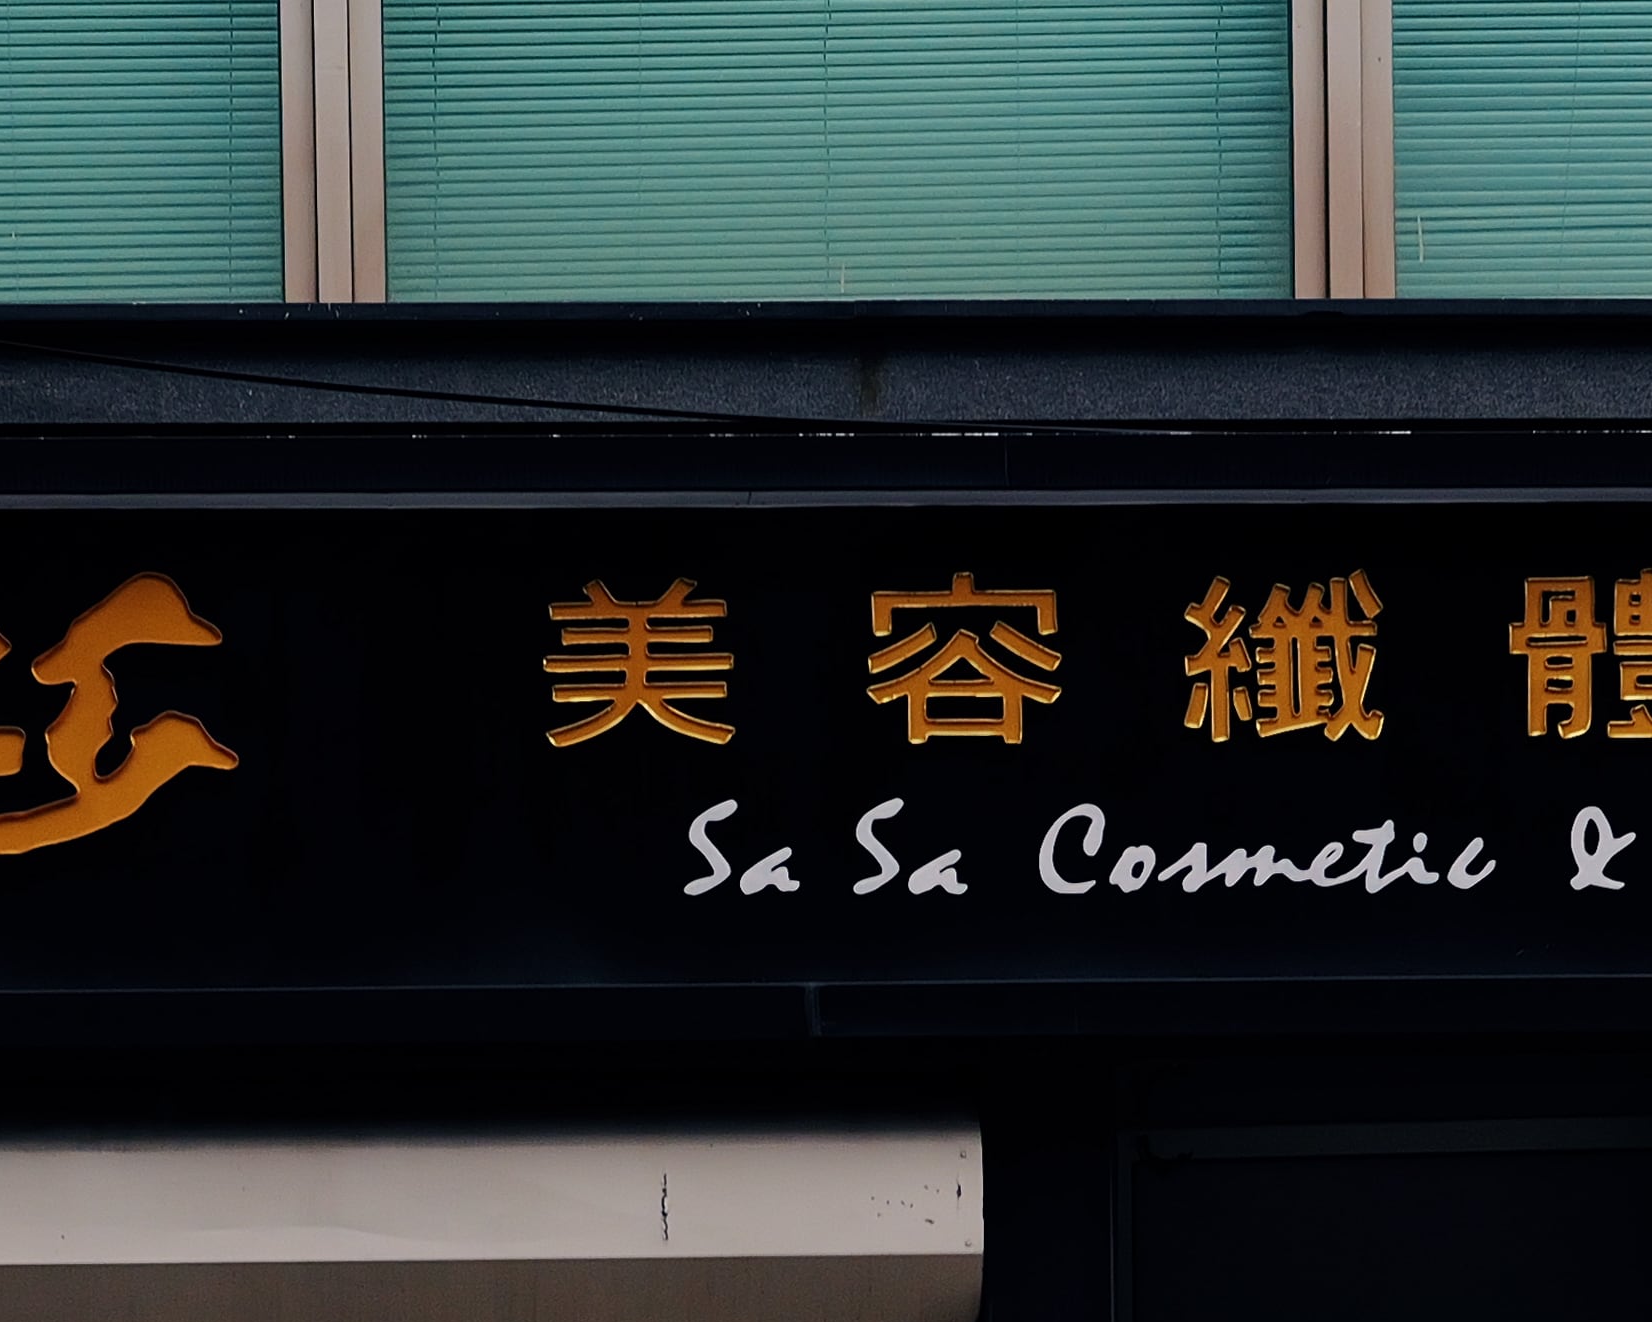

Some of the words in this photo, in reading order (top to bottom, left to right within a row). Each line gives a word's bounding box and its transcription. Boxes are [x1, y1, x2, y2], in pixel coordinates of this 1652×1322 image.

[684, 799, 800, 895] Sa
[853, 798, 968, 894] Sa
[1039, 804, 1496, 894] Cosmetic
[1570, 806, 1636, 890] &
